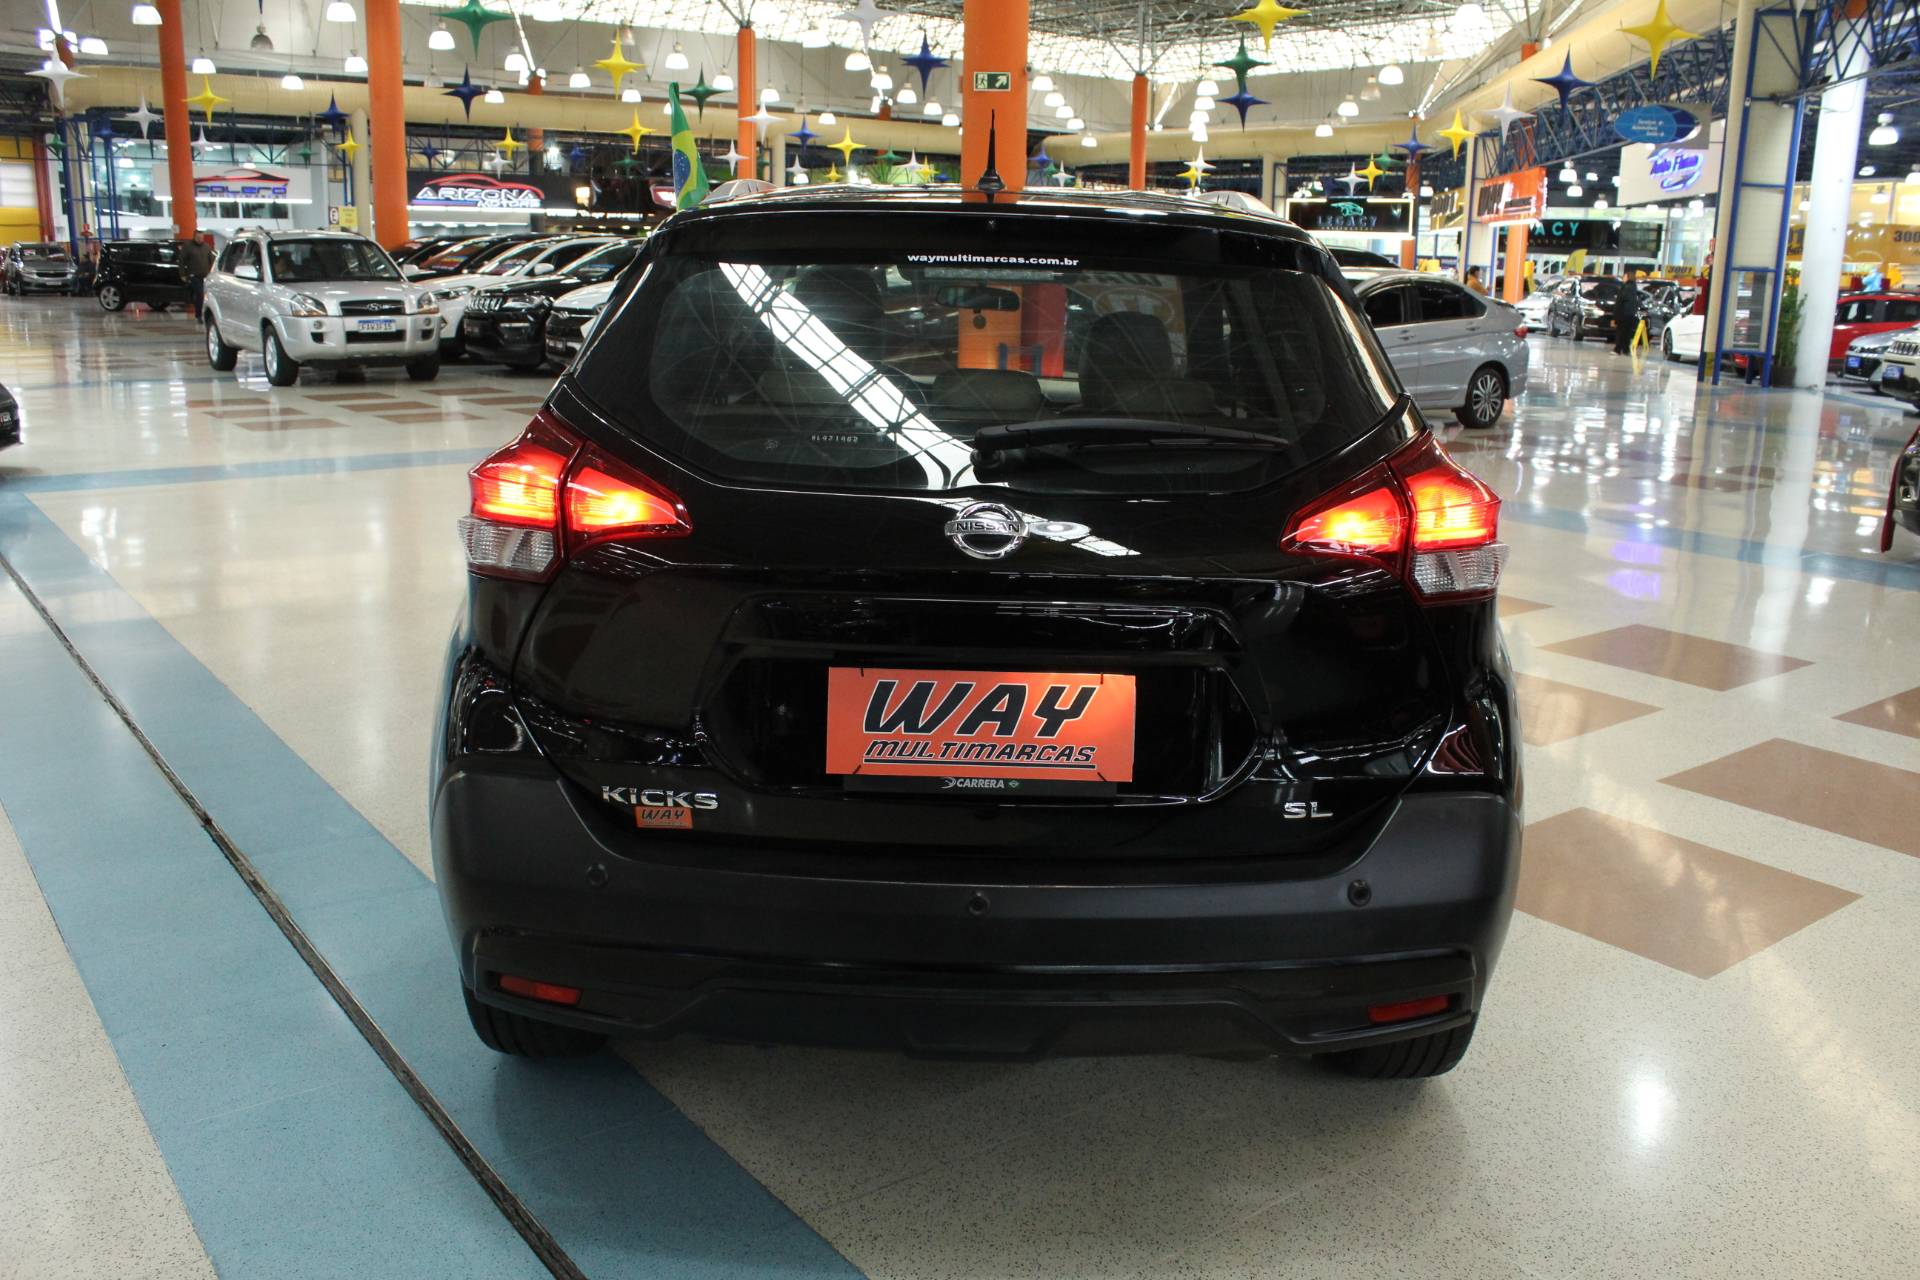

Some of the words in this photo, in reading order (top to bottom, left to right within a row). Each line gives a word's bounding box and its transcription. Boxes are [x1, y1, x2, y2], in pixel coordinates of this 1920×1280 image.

[416, 186, 542, 201] ARIZONA
[907, 253, 1080, 266] waymultimarcas.com.br
[955, 520, 1020, 533] NISSAN
[863, 679, 1099, 739] WAY
[863, 739, 1098, 764] MULTIMARCAS
[956, 777, 1005, 789] CARRERA
[600, 784, 719, 810] KICKS
[641, 809, 685, 820] WAY
[1283, 800, 1334, 819] SL
